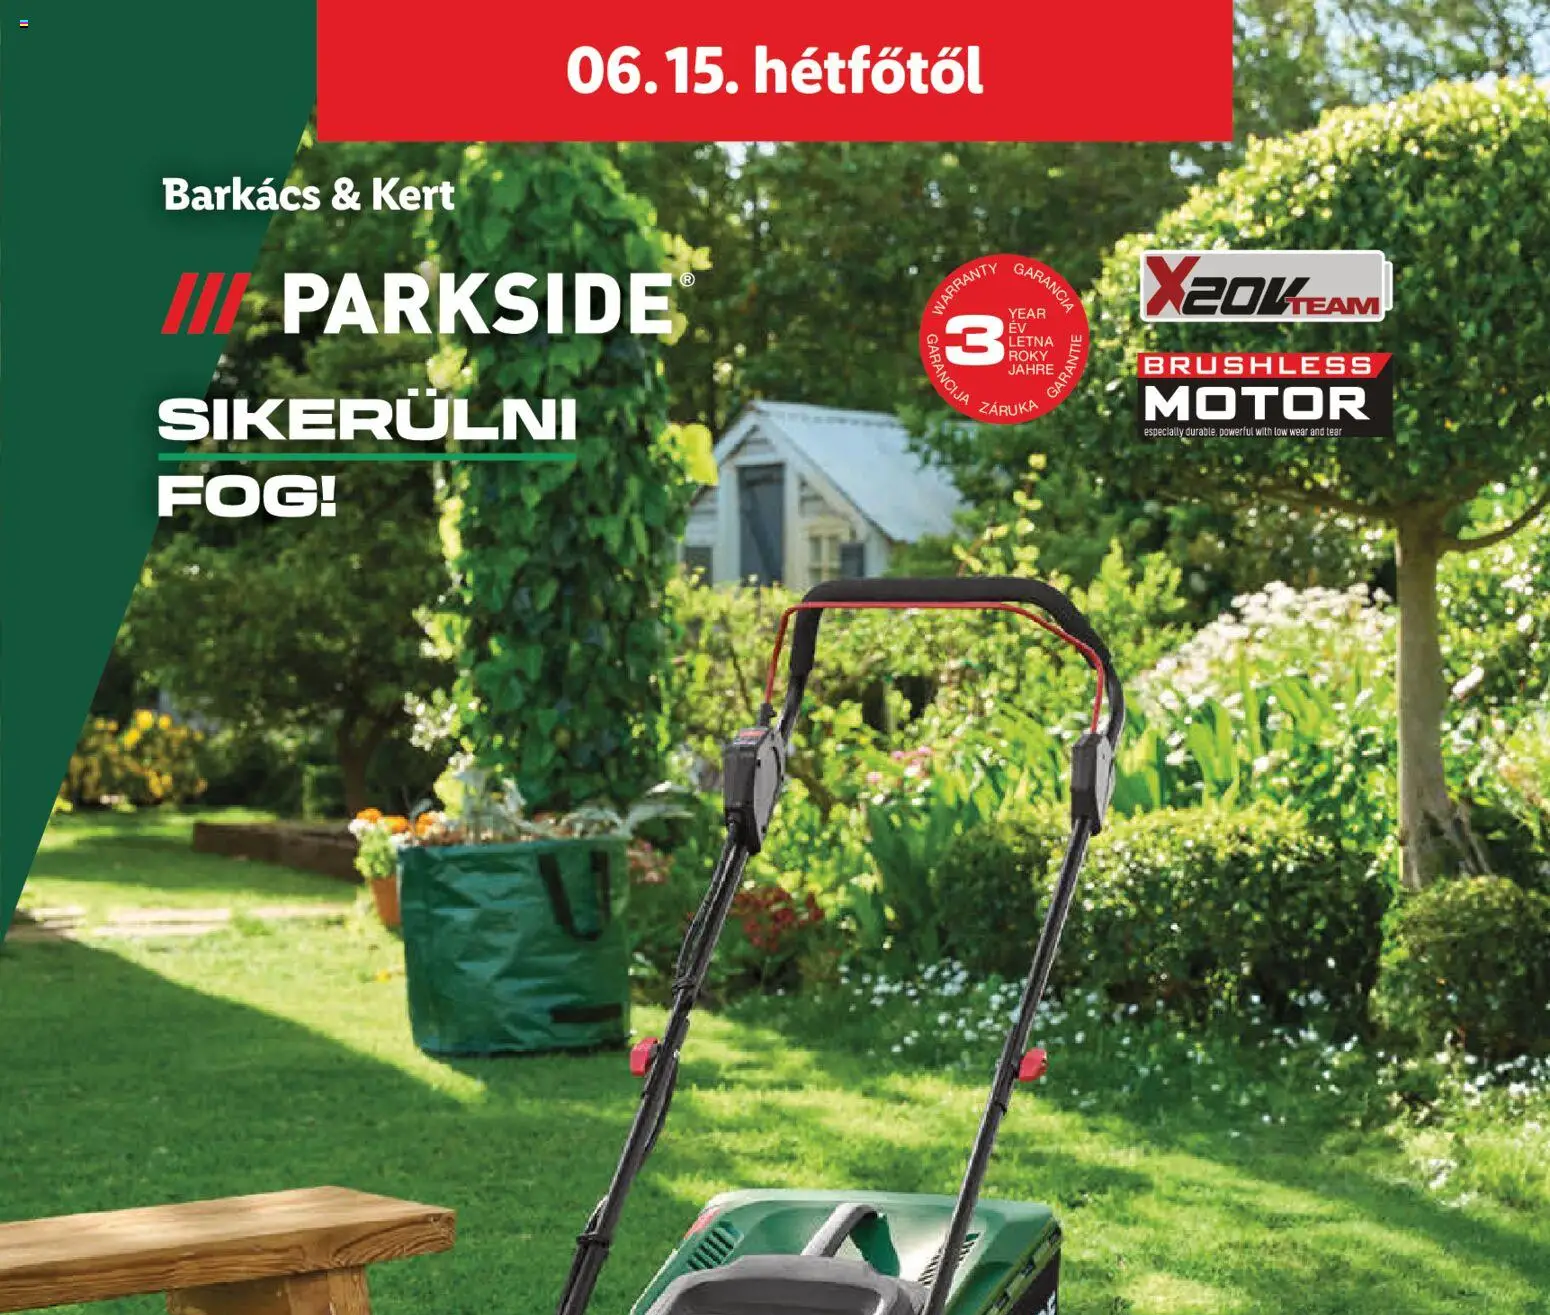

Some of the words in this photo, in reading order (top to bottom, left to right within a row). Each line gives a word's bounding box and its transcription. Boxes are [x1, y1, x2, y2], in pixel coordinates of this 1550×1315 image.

[755, 45, 984, 95] hétfőtől
[162, 176, 321, 211] Barkács
[331, 177, 361, 211] &
[373, 177, 455, 211] Kert
[932, 263, 997, 316] WARRANTY
[1013, 263, 1075, 314] GARANCIA
[1008, 308, 1047, 319] YEAR
[1008, 320, 1027, 334] ÉV
[945, 314, 1005, 367] 3
[1008, 336, 1054, 348] LETNA
[1008, 350, 1049, 362] ROKY
[926, 333, 970, 405] GARANCIJA
[1008, 364, 1054, 376] JAHRE
[1046, 334, 1083, 398] GARANTIE
[1144, 356, 1371, 375] BRUSHLESS
[158, 388, 576, 441] SIKERÜLNI
[979, 399, 1039, 417] ZÁRUKA
[1144, 385, 1371, 421] MOTOR
[1144, 427, 1184, 438] especially
[1219, 427, 1254, 438] powerful
[1255, 427, 1273, 437] with
[1274, 427, 1288, 437] low
[1289, 428, 1308, 437] wear
[1310, 427, 1325, 437] and
[1326, 427, 1342, 437] tear
[158, 474, 337, 517] FOG!
